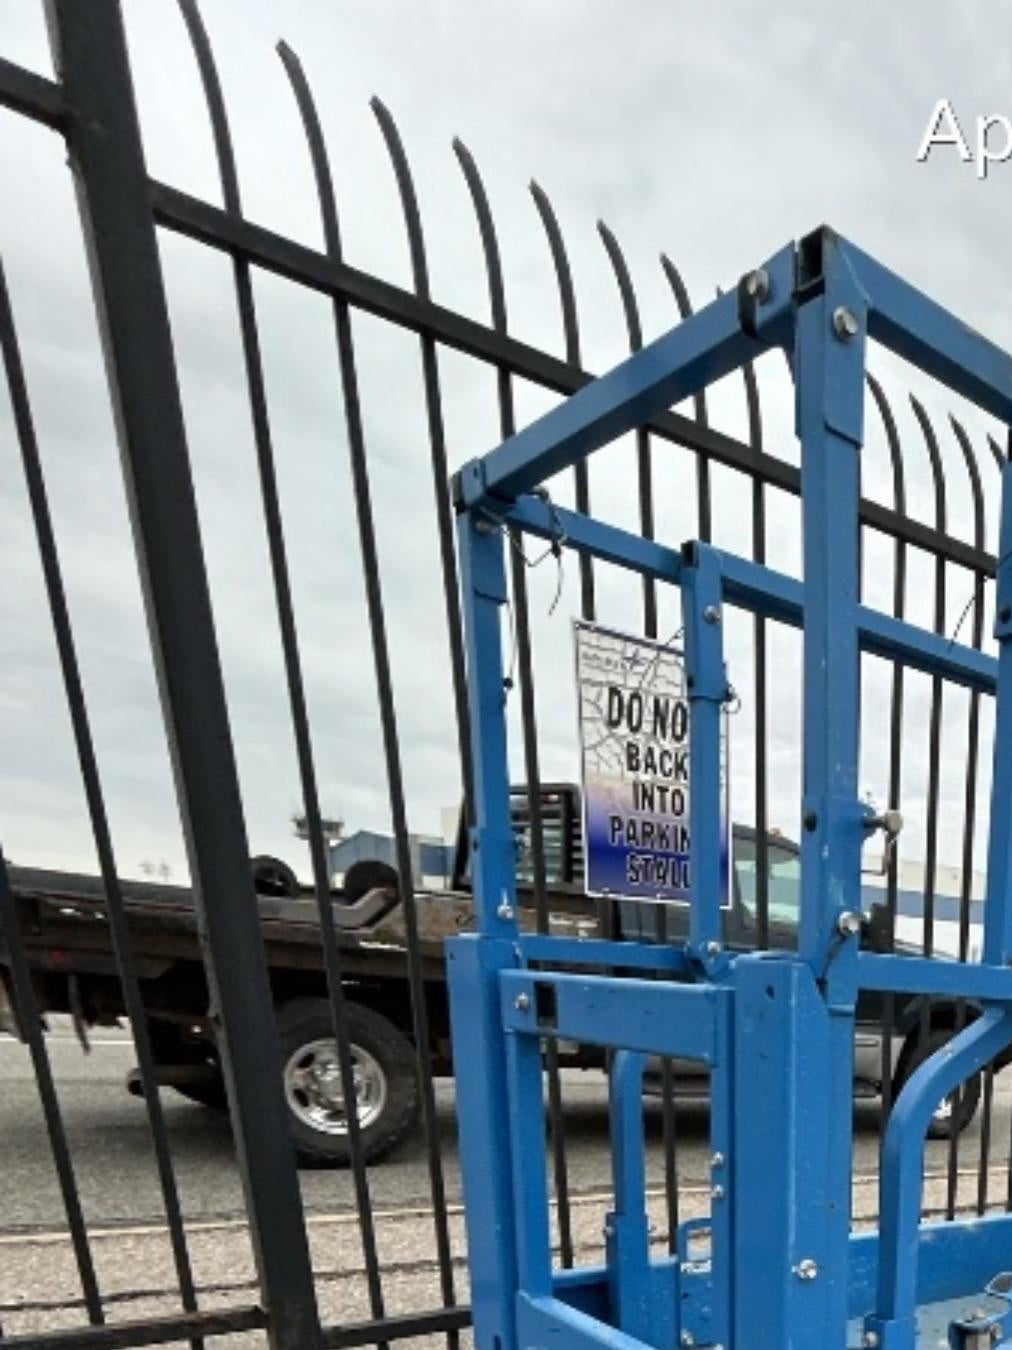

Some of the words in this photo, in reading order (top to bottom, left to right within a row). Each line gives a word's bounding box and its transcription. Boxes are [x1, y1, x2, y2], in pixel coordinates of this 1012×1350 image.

[606, 686, 643, 734] DO
[653, 697, 688, 742] NO
[626, 741, 688, 781] BACK
[633, 783, 686, 817] INTO
[609, 815, 690, 852] PARKIN
